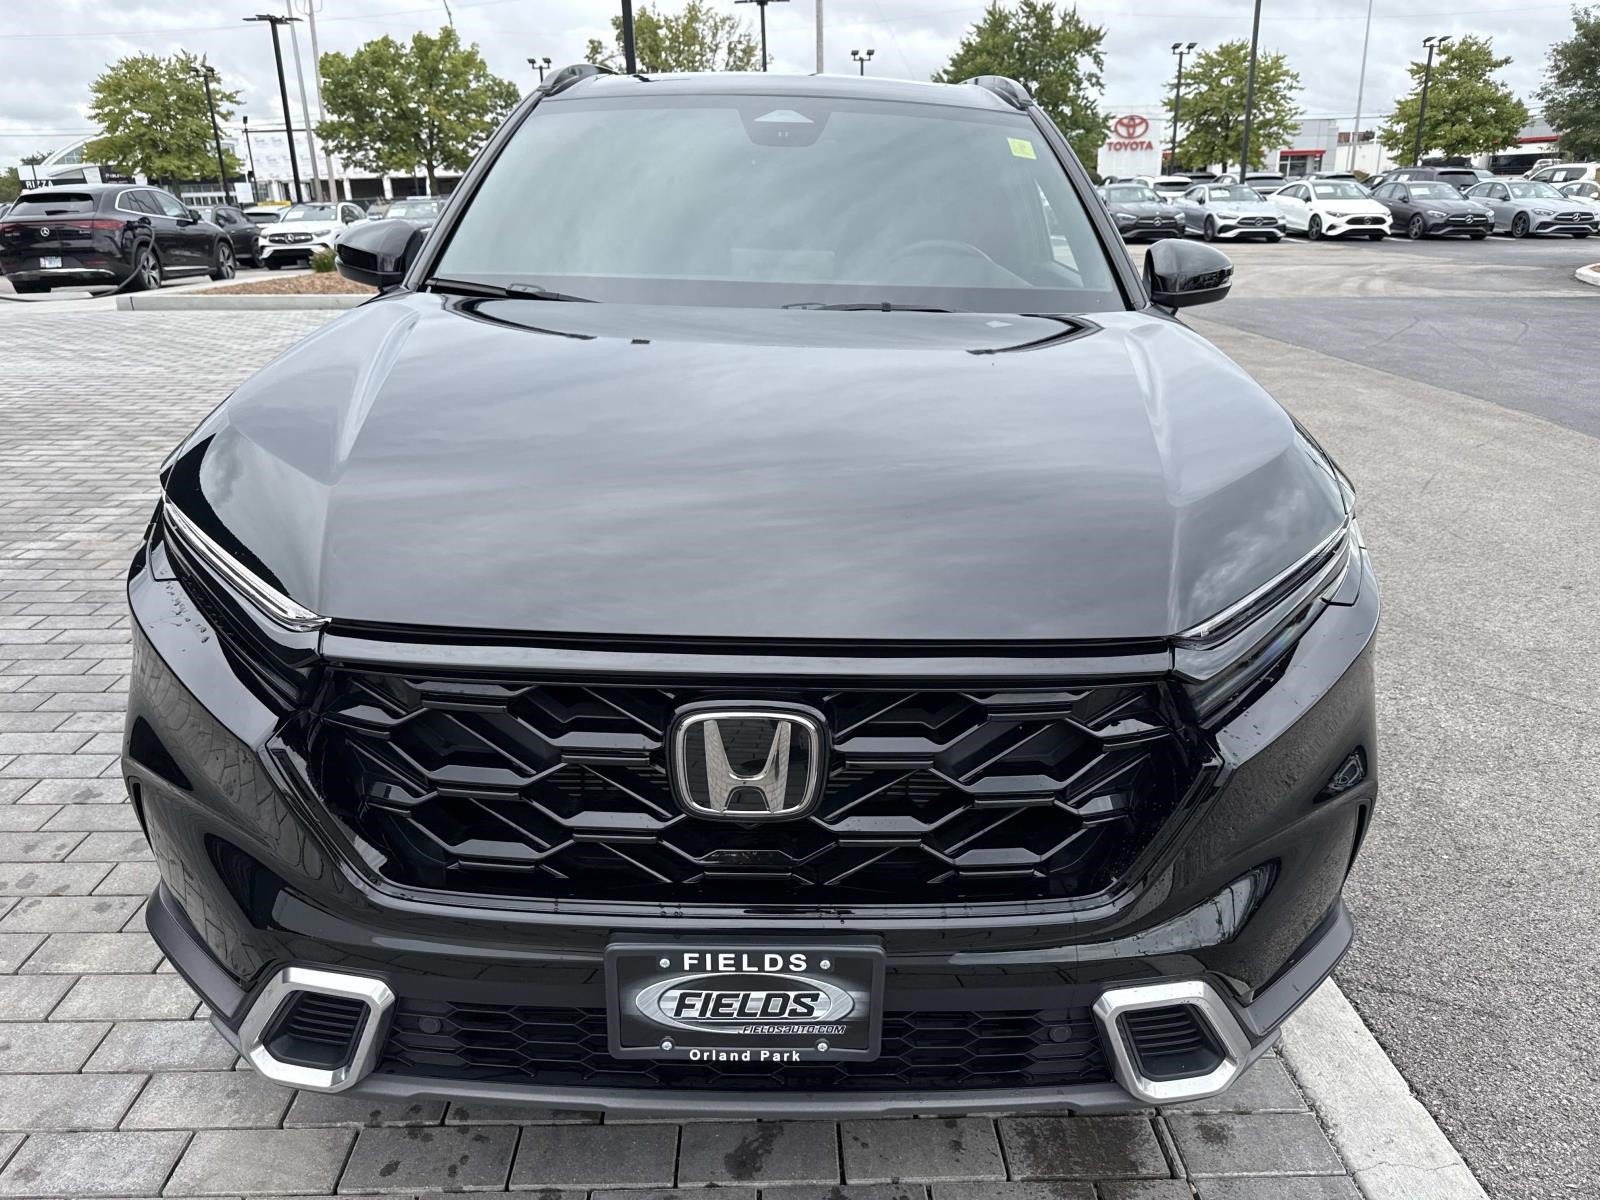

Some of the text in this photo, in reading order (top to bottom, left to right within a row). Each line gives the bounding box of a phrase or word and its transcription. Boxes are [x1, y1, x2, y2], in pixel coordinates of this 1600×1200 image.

[1106, 141, 1153, 152] TOYOTA
[683, 952, 808, 972] FIELDS
[673, 991, 821, 1018] FIELDS
[689, 1049, 801, 1062] Orland Park
